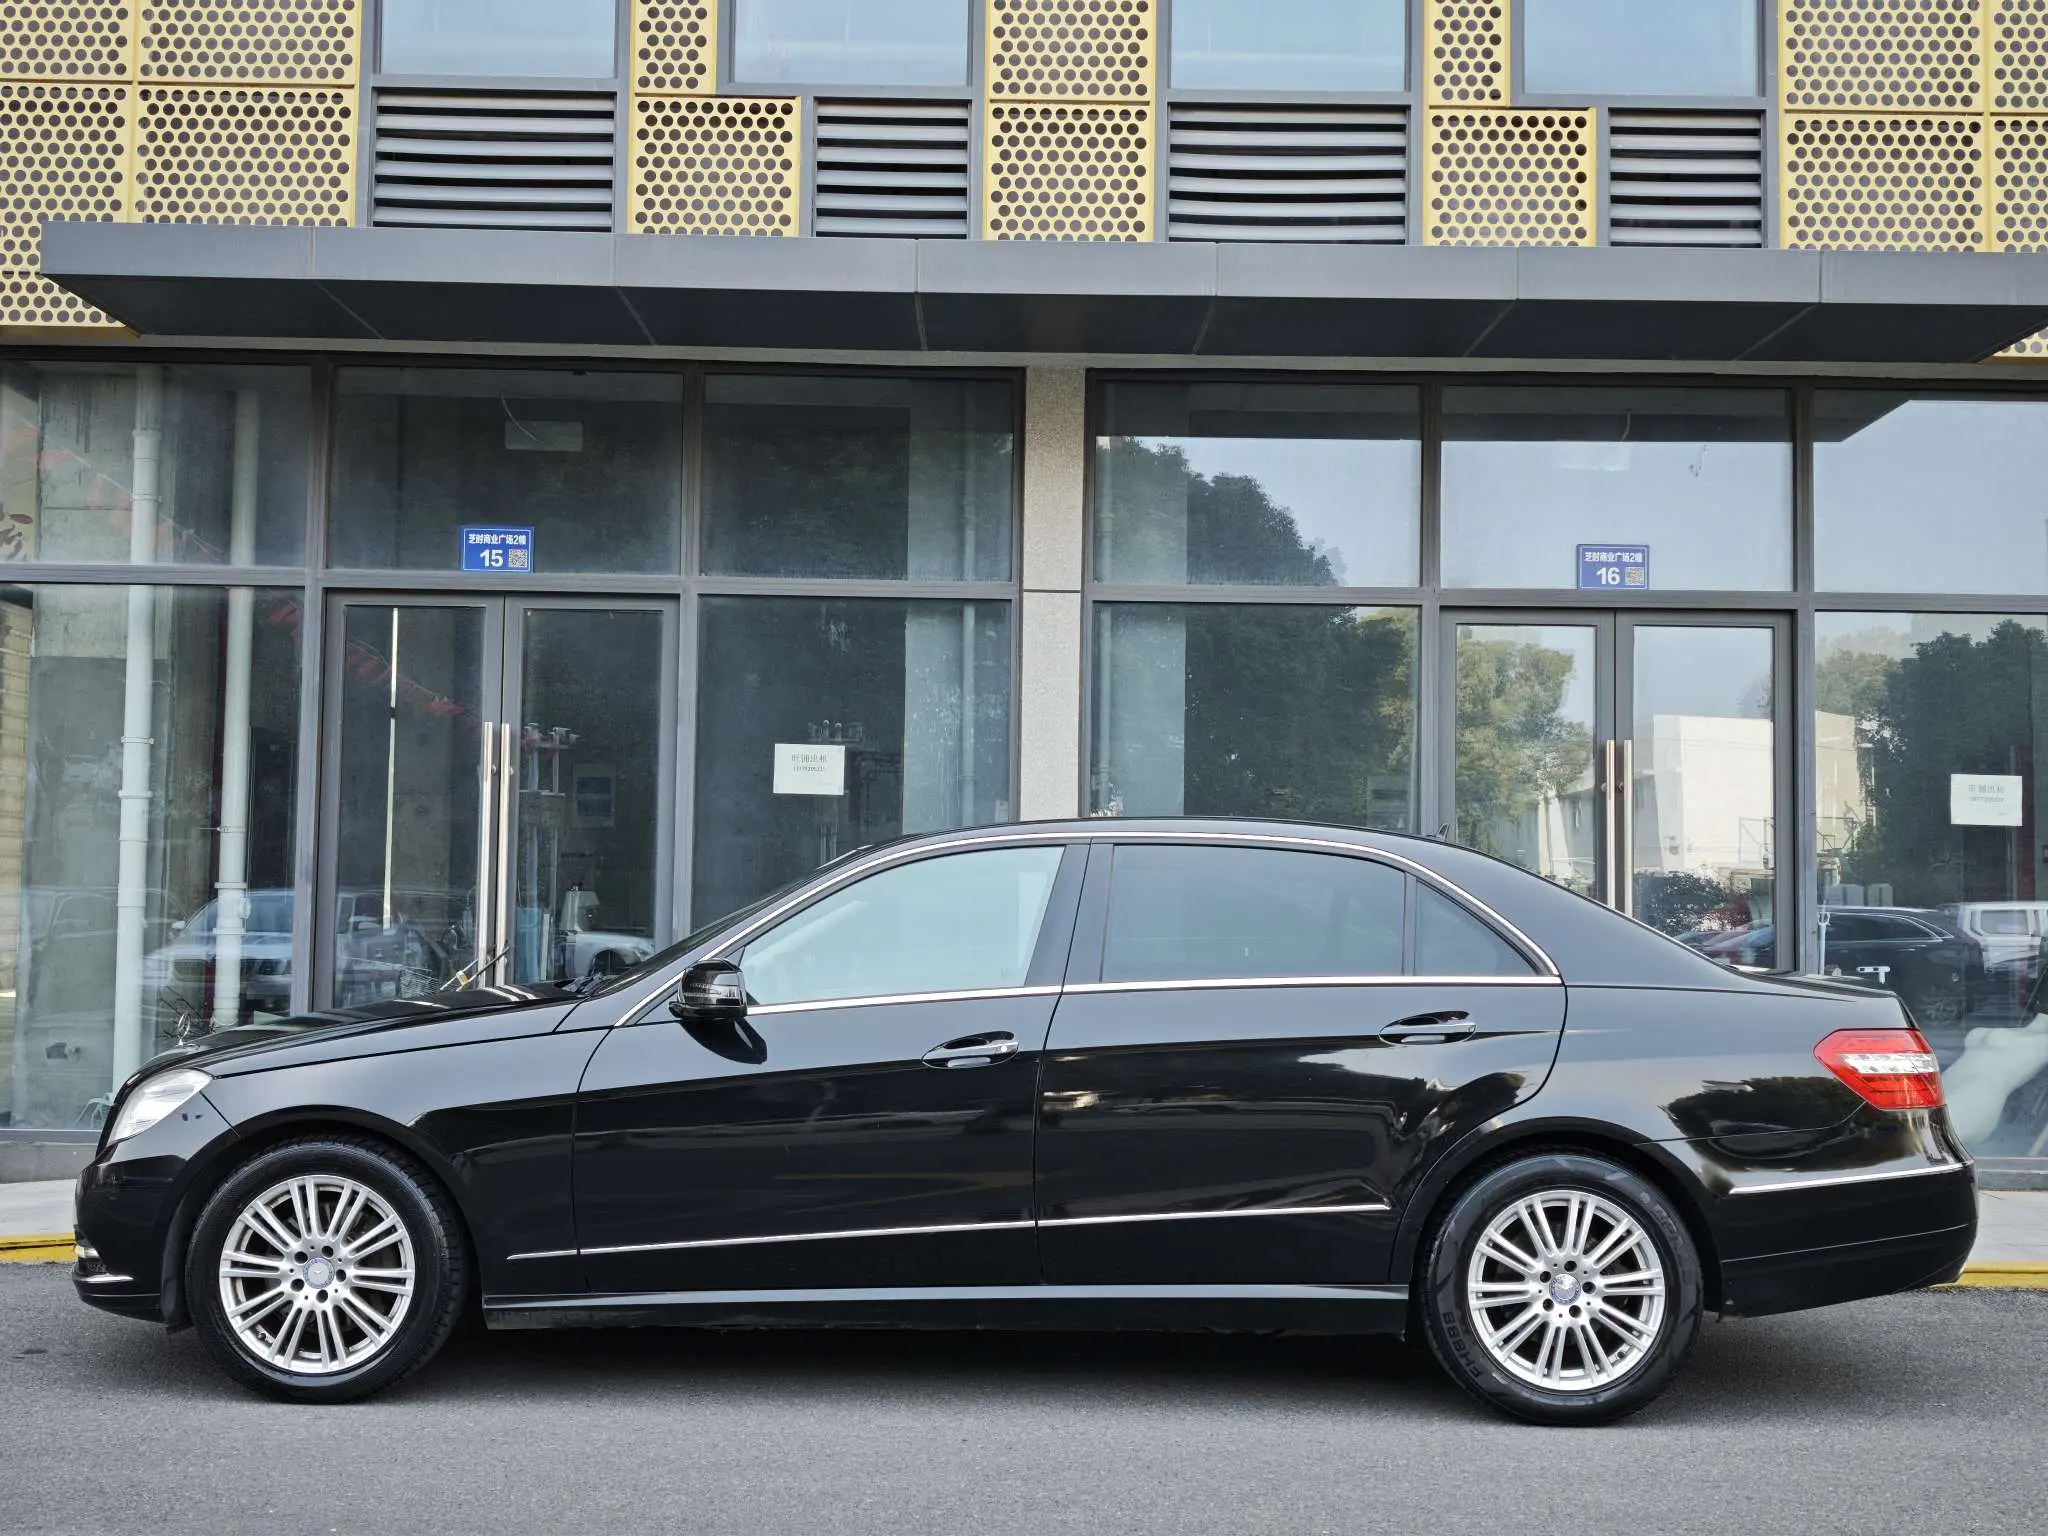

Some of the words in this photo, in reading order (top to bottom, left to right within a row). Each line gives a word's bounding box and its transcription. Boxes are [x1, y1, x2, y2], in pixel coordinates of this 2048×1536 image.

[480, 549, 504, 567] 15
[1596, 567, 1621, 585] 16
[1442, 1311, 1484, 1379] FH888
